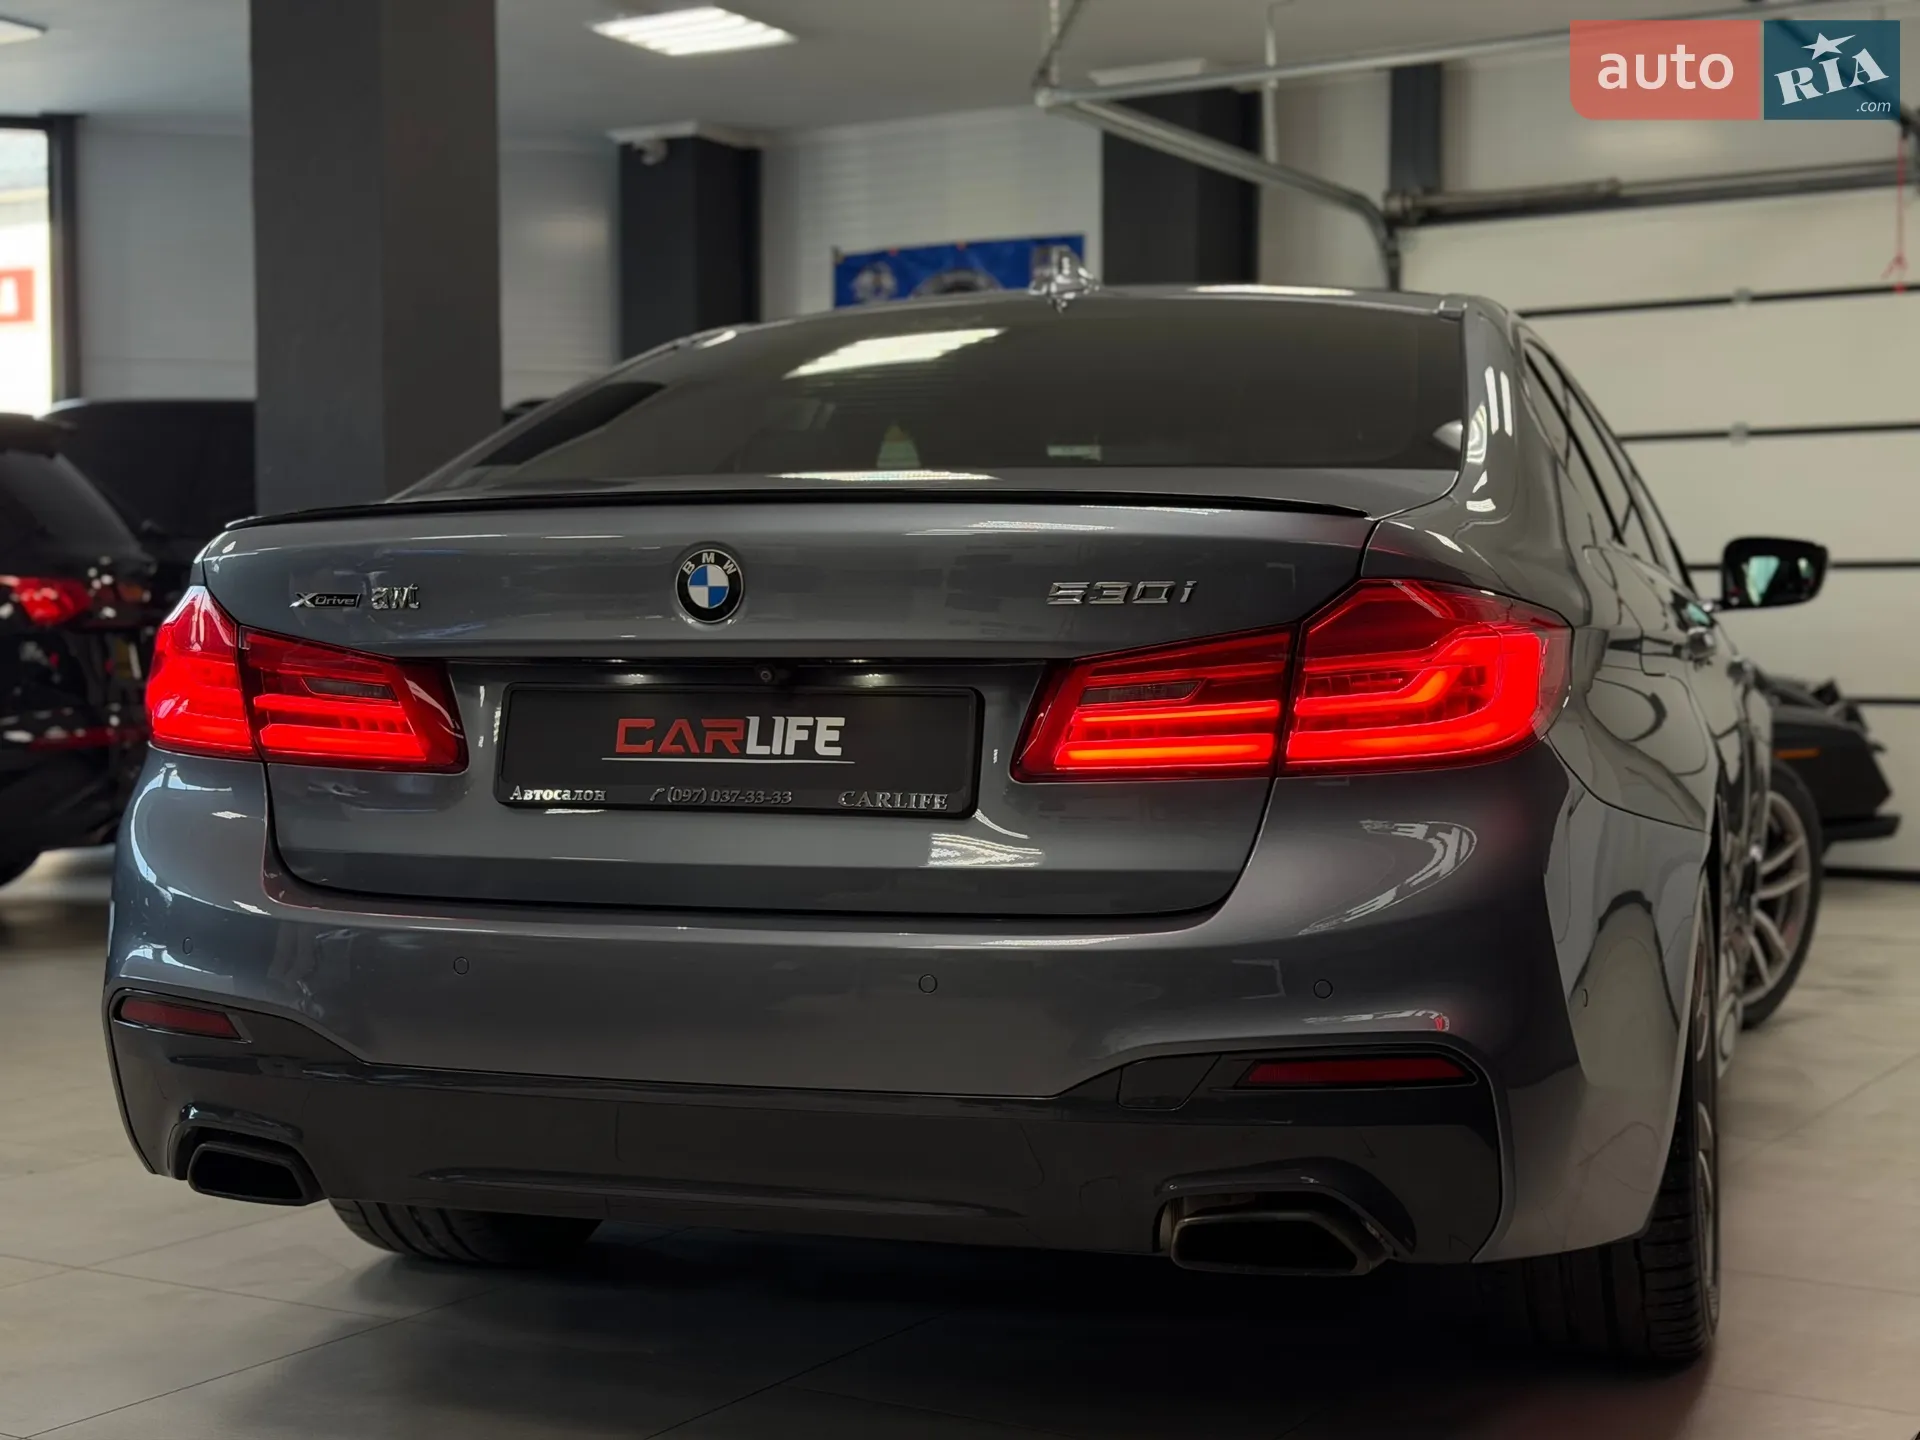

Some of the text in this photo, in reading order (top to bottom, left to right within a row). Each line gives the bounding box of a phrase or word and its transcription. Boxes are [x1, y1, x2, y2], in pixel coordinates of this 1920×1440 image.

[682, 552, 737, 575] BMW
[1046, 580, 1198, 605] 530i
[509, 785, 607, 801] Автосалон
[667, 786, 792, 804] (097) 037-33-33
[838, 790, 949, 810] CARLIFE
